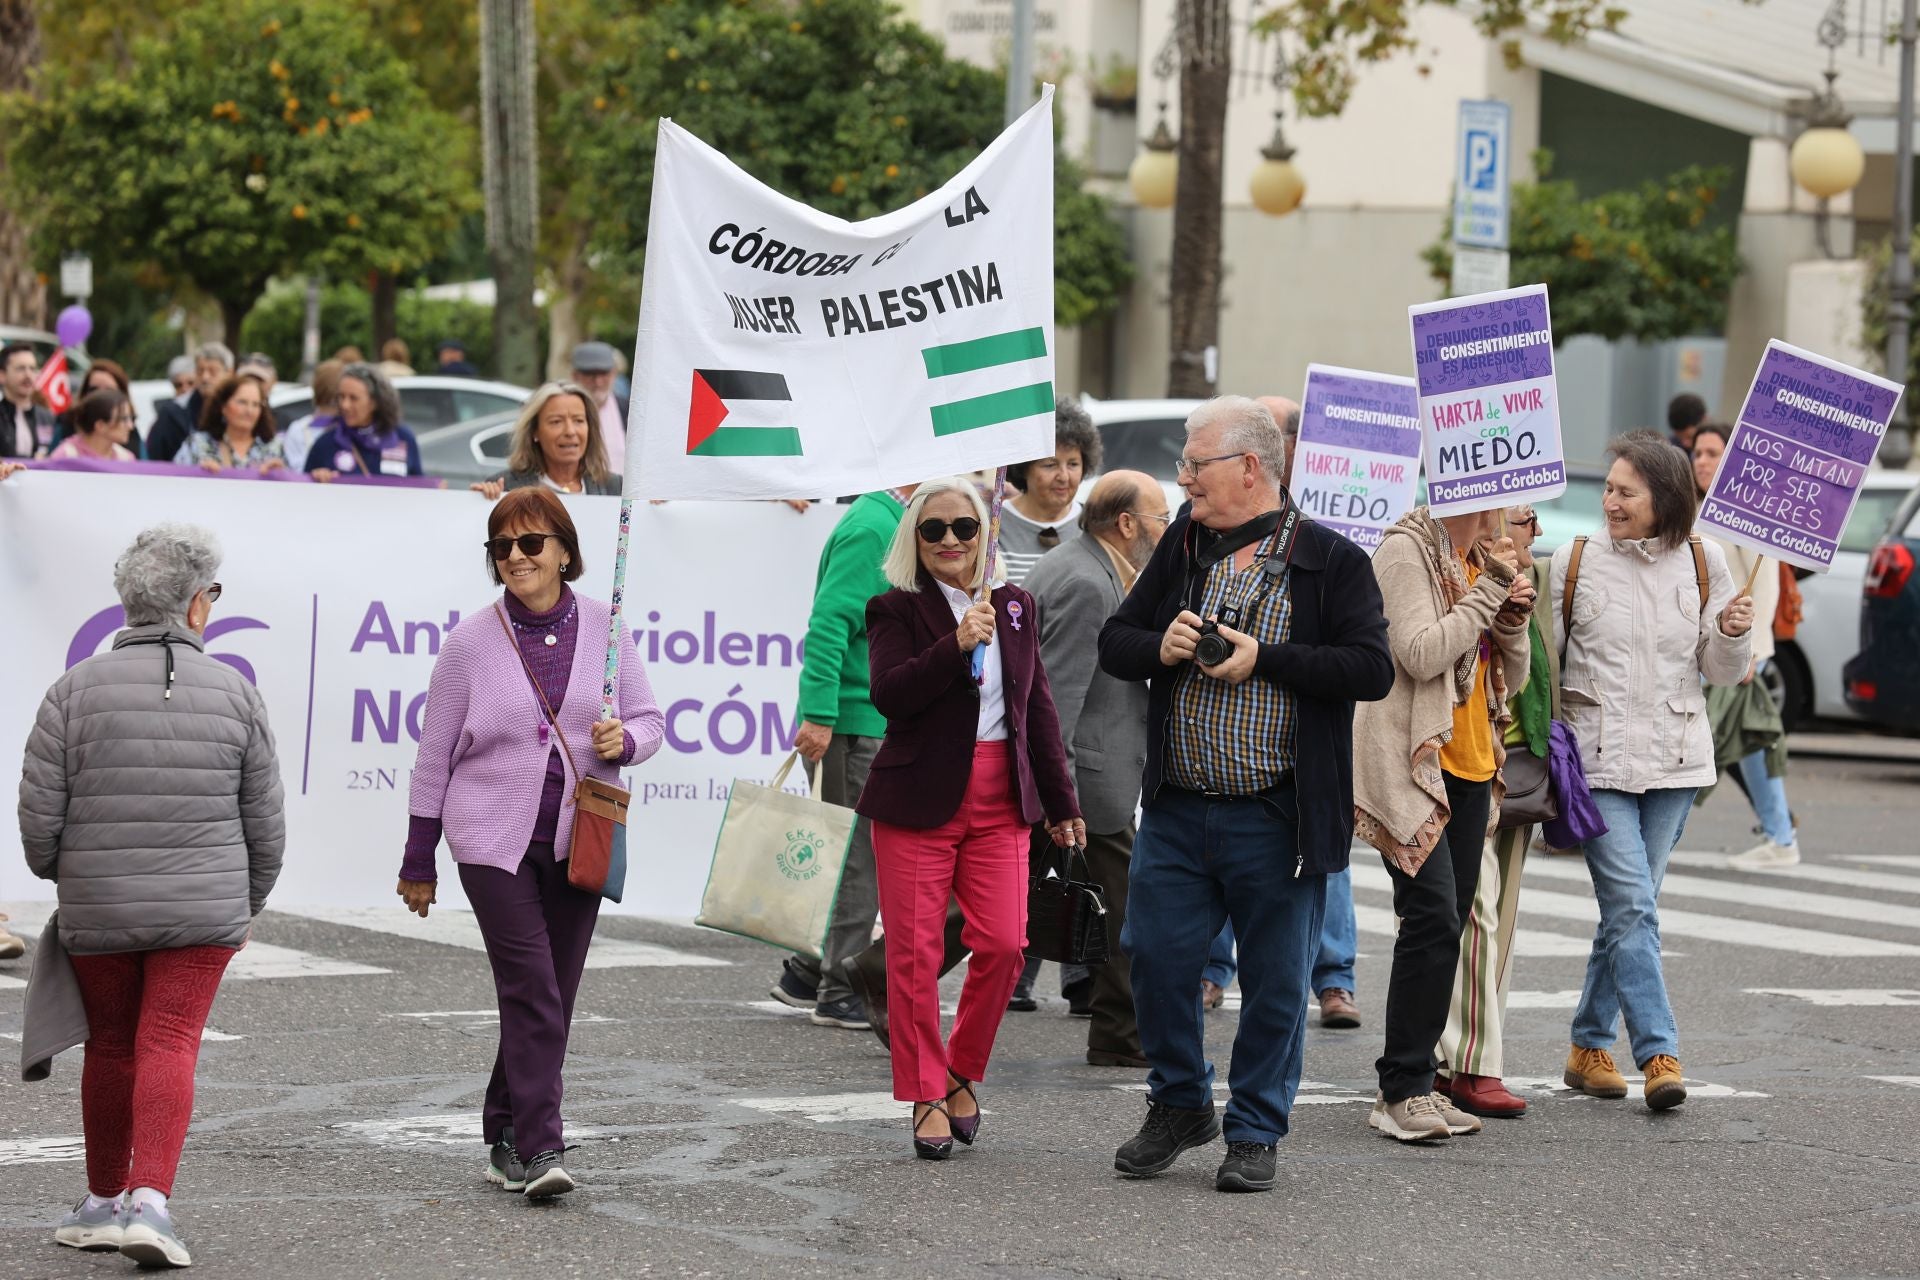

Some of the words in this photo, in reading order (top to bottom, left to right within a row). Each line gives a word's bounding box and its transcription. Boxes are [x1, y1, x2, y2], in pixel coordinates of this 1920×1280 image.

[708, 223, 864, 277] CÓRDOBA
[944, 185, 990, 228] LA
[724, 292, 801, 334] MUJER
[821, 262, 1003, 337] PALESTINA
[1416, 348, 1438, 365] SIN
[1440, 330, 1550, 361] CONSENTIMIENTO
[1426, 323, 1498, 348] DENUNCIES
[1501, 322, 1510, 335] O
[1443, 360, 1458, 375] ES
[1317, 391, 1382, 412] DENUNCIES
[1770, 371, 1842, 407] DENUNCIES
[1842, 398, 1852, 411] O
[1325, 405, 1421, 431] CONSENTIMIENTO
[1432, 399, 1484, 432] HARTA
[1486, 402, 1500, 419] de
[1503, 388, 1544, 414] VIVIR
[1753, 380, 1776, 398] SIN
[1776, 388, 1885, 437] CONSENTIMIENTO
[1771, 402, 1789, 418] ES
[1480, 425, 1510, 438] con
[1305, 450, 1351, 476] HARTA
[1352, 463, 1365, 479] de
[1370, 461, 1404, 483] VIVIR
[1439, 431, 1541, 474] MIEDO.
[1741, 431, 1784, 461] NOS
[1789, 450, 1852, 486] MATAN
[1342, 484, 1368, 497] con
[1434, 480, 1498, 501] Podemos
[1501, 467, 1560, 490] Córdoba
[1740, 458, 1776, 489] POR
[1783, 476, 1821, 505] SER
[1285, 511, 1296, 528] EOS
[1300, 487, 1391, 521] MIEDO.
[1276, 528, 1289, 554] DIGITAL
[1349, 526, 1384, 545] Córd
[1705, 502, 1769, 539] Podemos
[1771, 528, 1832, 562] Córdoba
[347, 768, 397, 790] 25N
[643, 780, 697, 804] para
[708, 778, 728, 800] la
[785, 828, 825, 849] EKKO
[776, 853, 800, 880] GREEN
